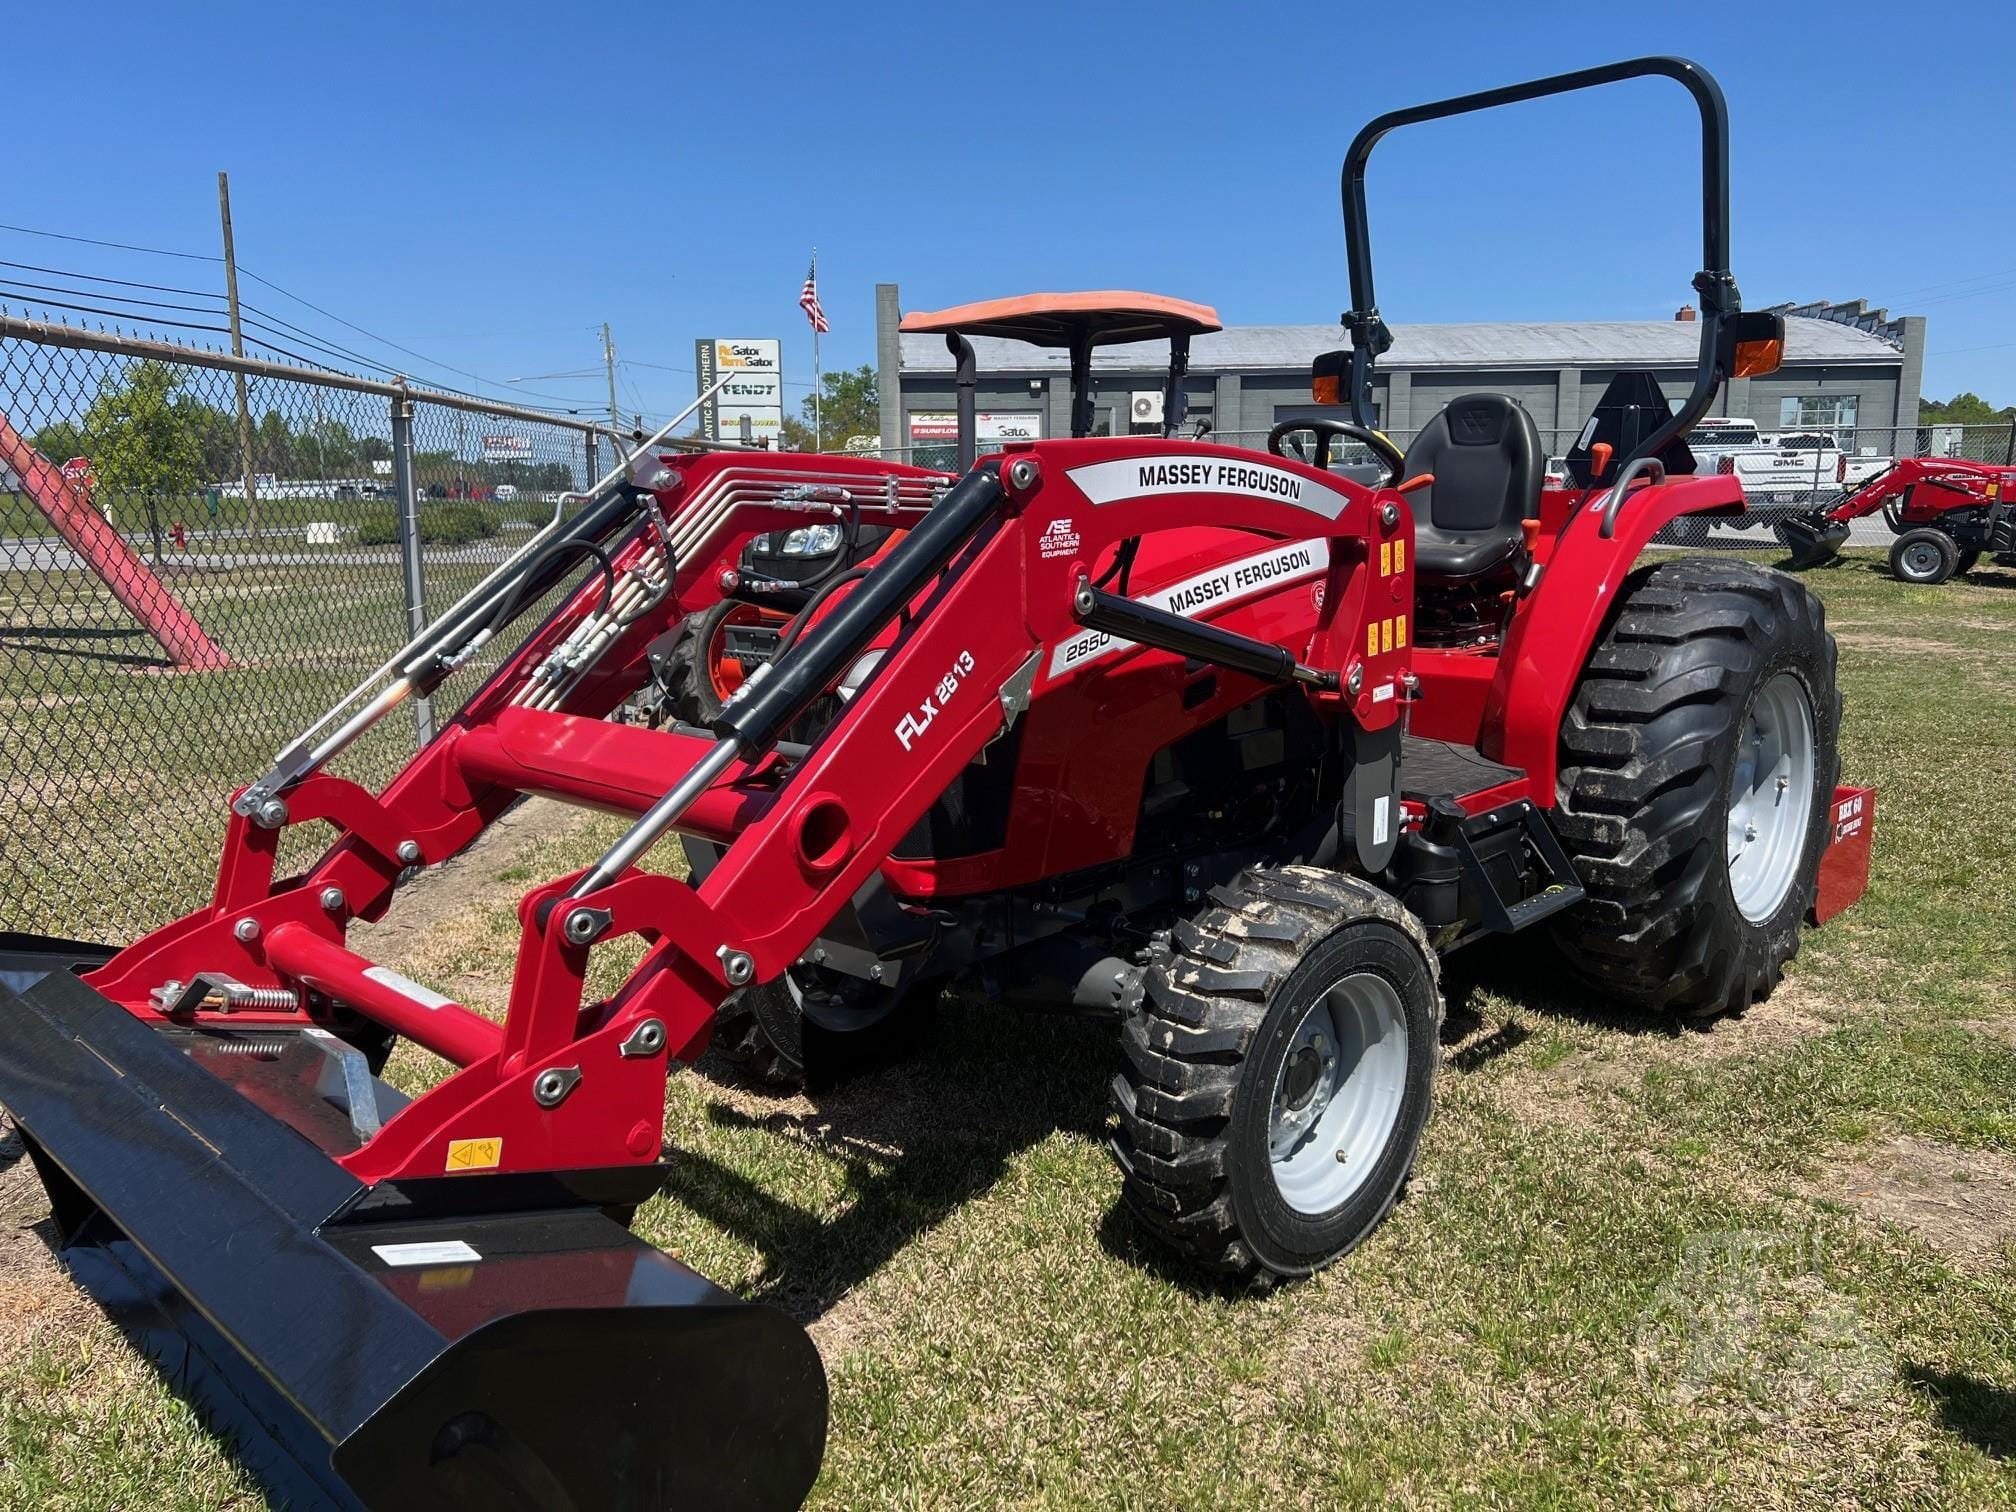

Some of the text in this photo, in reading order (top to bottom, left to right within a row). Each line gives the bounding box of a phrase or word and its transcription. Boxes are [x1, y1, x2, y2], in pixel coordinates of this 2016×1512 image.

[701, 345, 714, 442] ANTIC & OUTHERN
[722, 384, 776, 395] FENDT
[1773, 459, 1805, 467] GMC
[1138, 464, 1301, 500] MASSEY FERGUSON
[1039, 532, 1080, 543] ATLANTIC &
[1040, 540, 1080, 550] SOUTHERN
[1041, 548, 1079, 558] EQUIPMENT
[1168, 549, 1311, 614] MASSEY FERGUSON
[1065, 632, 1111, 663] 2850
[934, 650, 975, 705] 2813
[1853, 796, 1863, 814] 60
